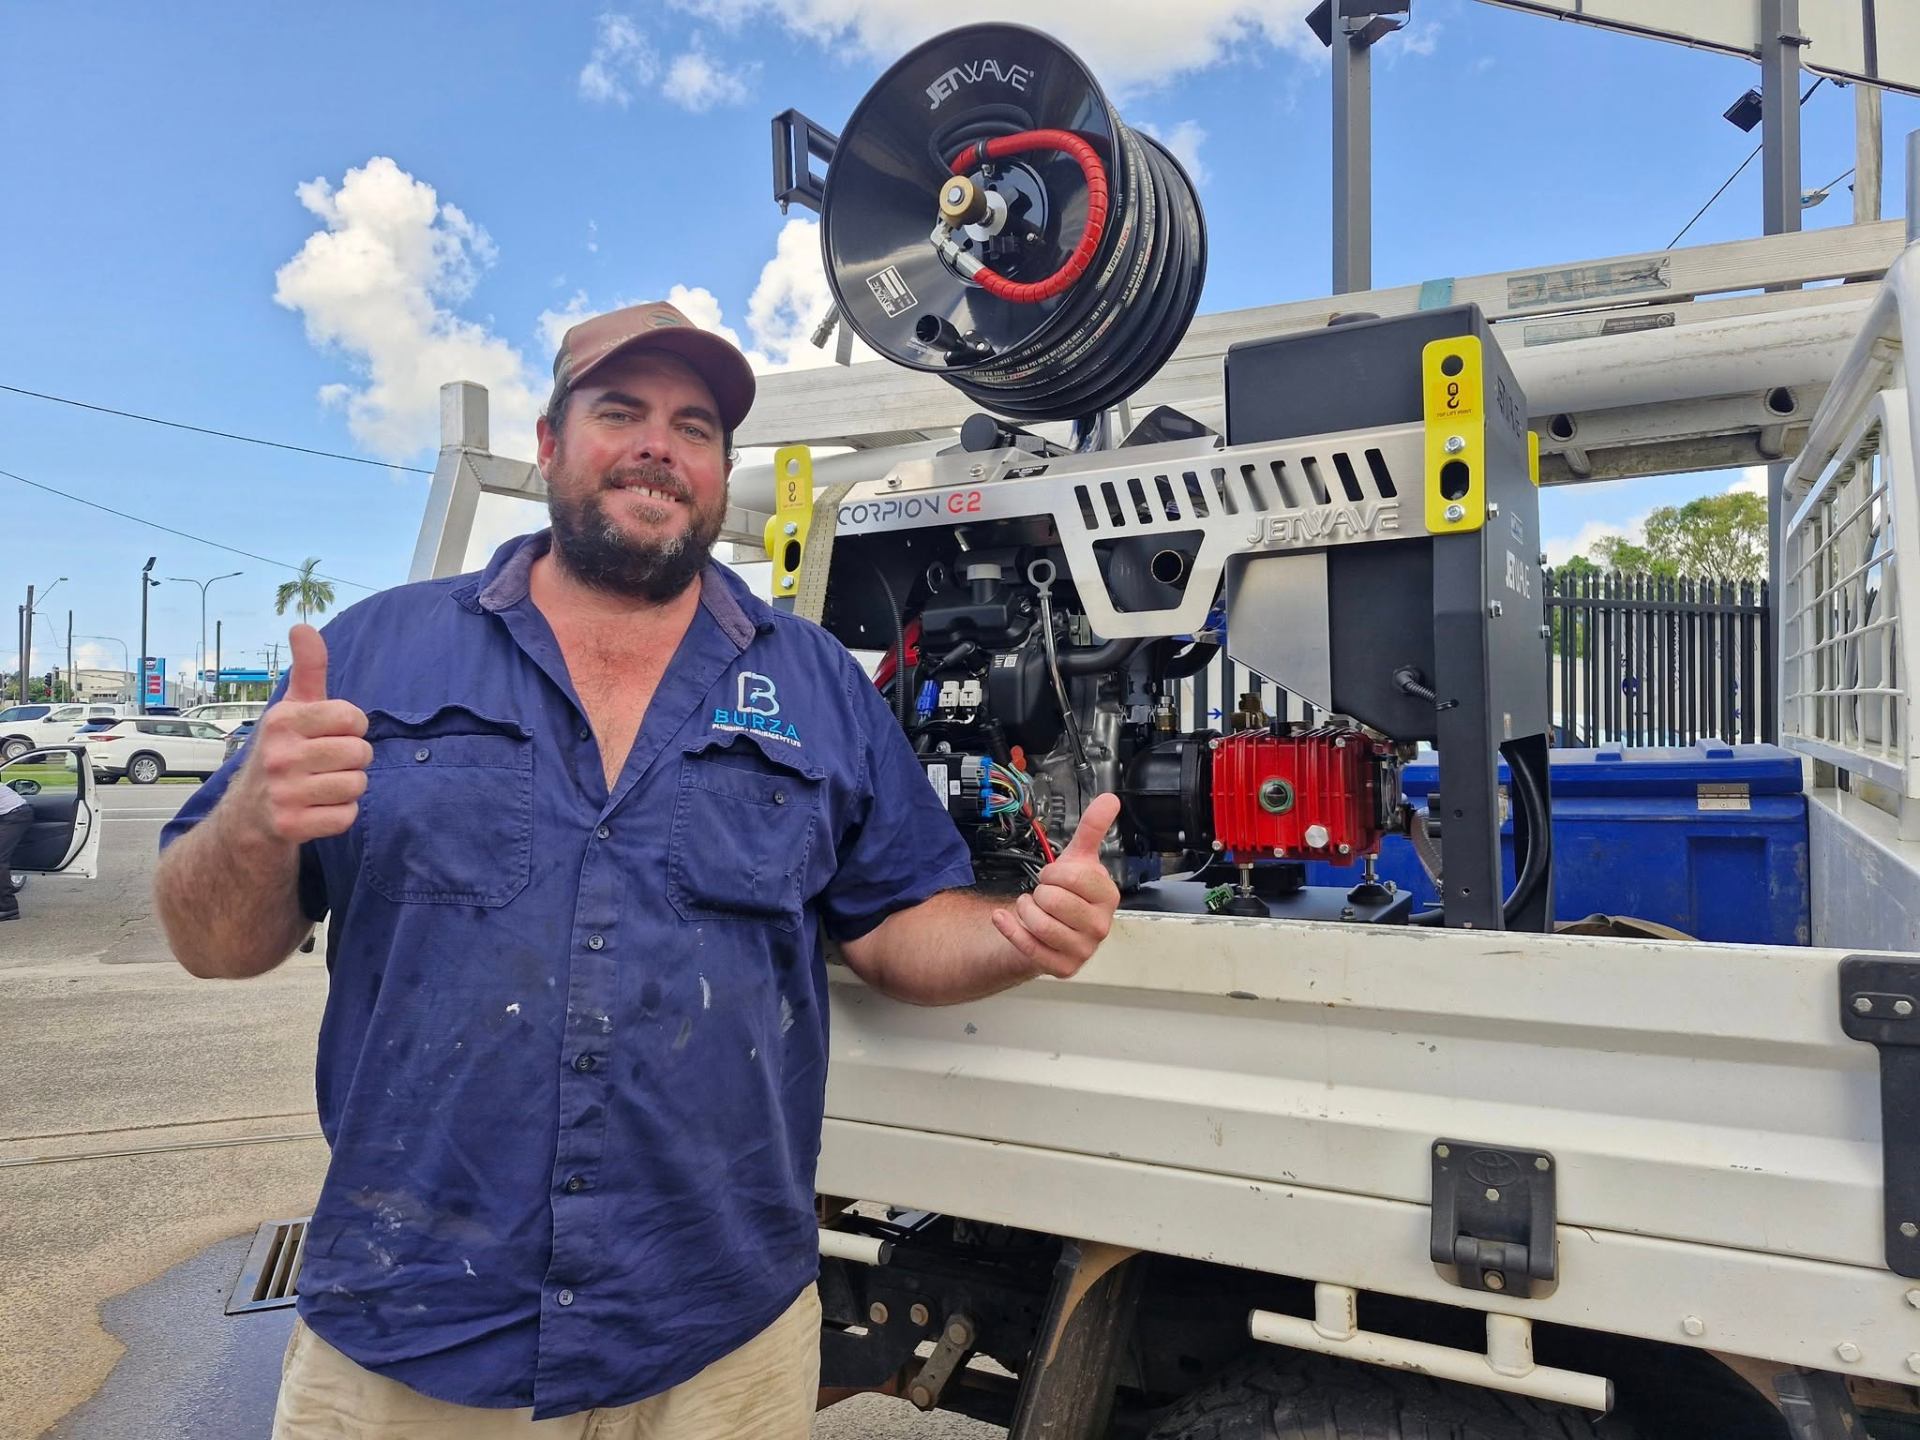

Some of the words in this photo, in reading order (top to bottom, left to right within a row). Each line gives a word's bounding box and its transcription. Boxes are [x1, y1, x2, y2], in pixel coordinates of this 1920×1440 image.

[925, 59, 1029, 110] JETWAVE
[838, 495, 940, 526] CORPION
[947, 491, 982, 514] G2
[1246, 502, 1400, 544] JETWAVE
[713, 708, 800, 740] BURZA
